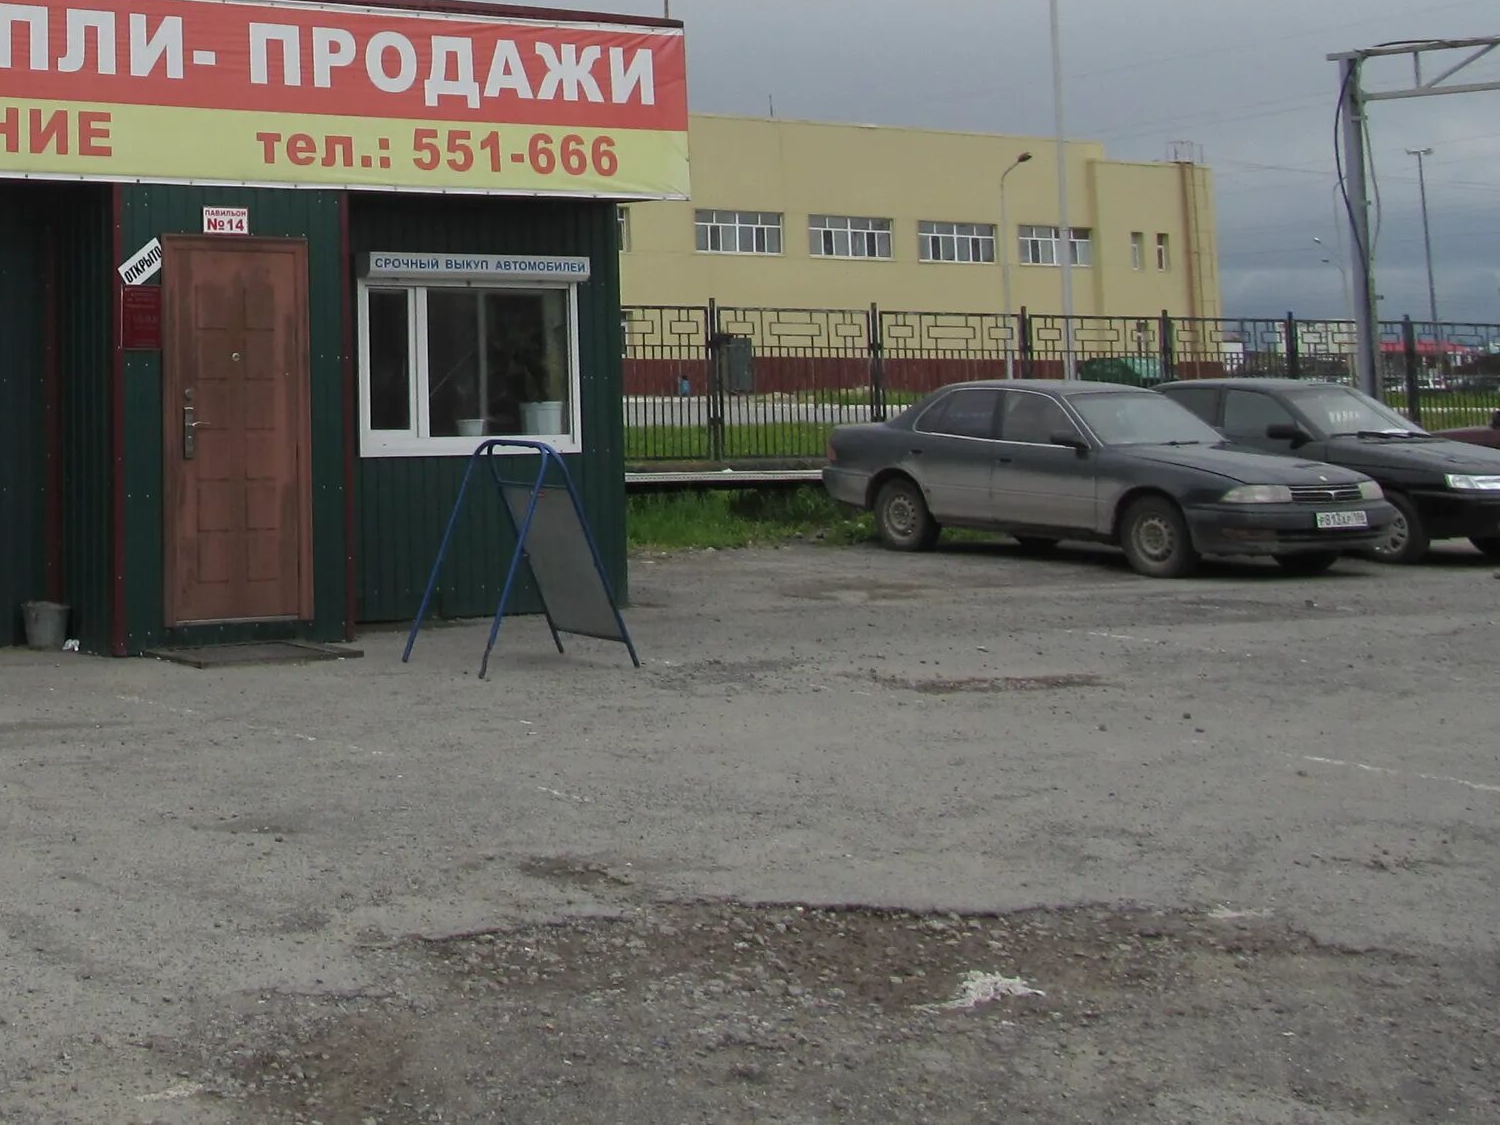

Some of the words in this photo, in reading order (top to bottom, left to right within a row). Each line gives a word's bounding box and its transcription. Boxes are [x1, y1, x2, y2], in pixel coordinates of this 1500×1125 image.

[248, 22, 656, 109] ПРОДАЖИ
[256, 131, 392, 169] тел.:
[412, 127, 619, 177] 551-666
[204, 209, 247, 217] ПАВИЛЬОН
[124, 245, 162, 284] ОТКРЫТО
[375, 257, 439, 270] СРОЧНЫЙ
[445, 259, 489, 270] ВЫКУП
[495, 260, 586, 273] АВТОМОБИЛЕЙ
